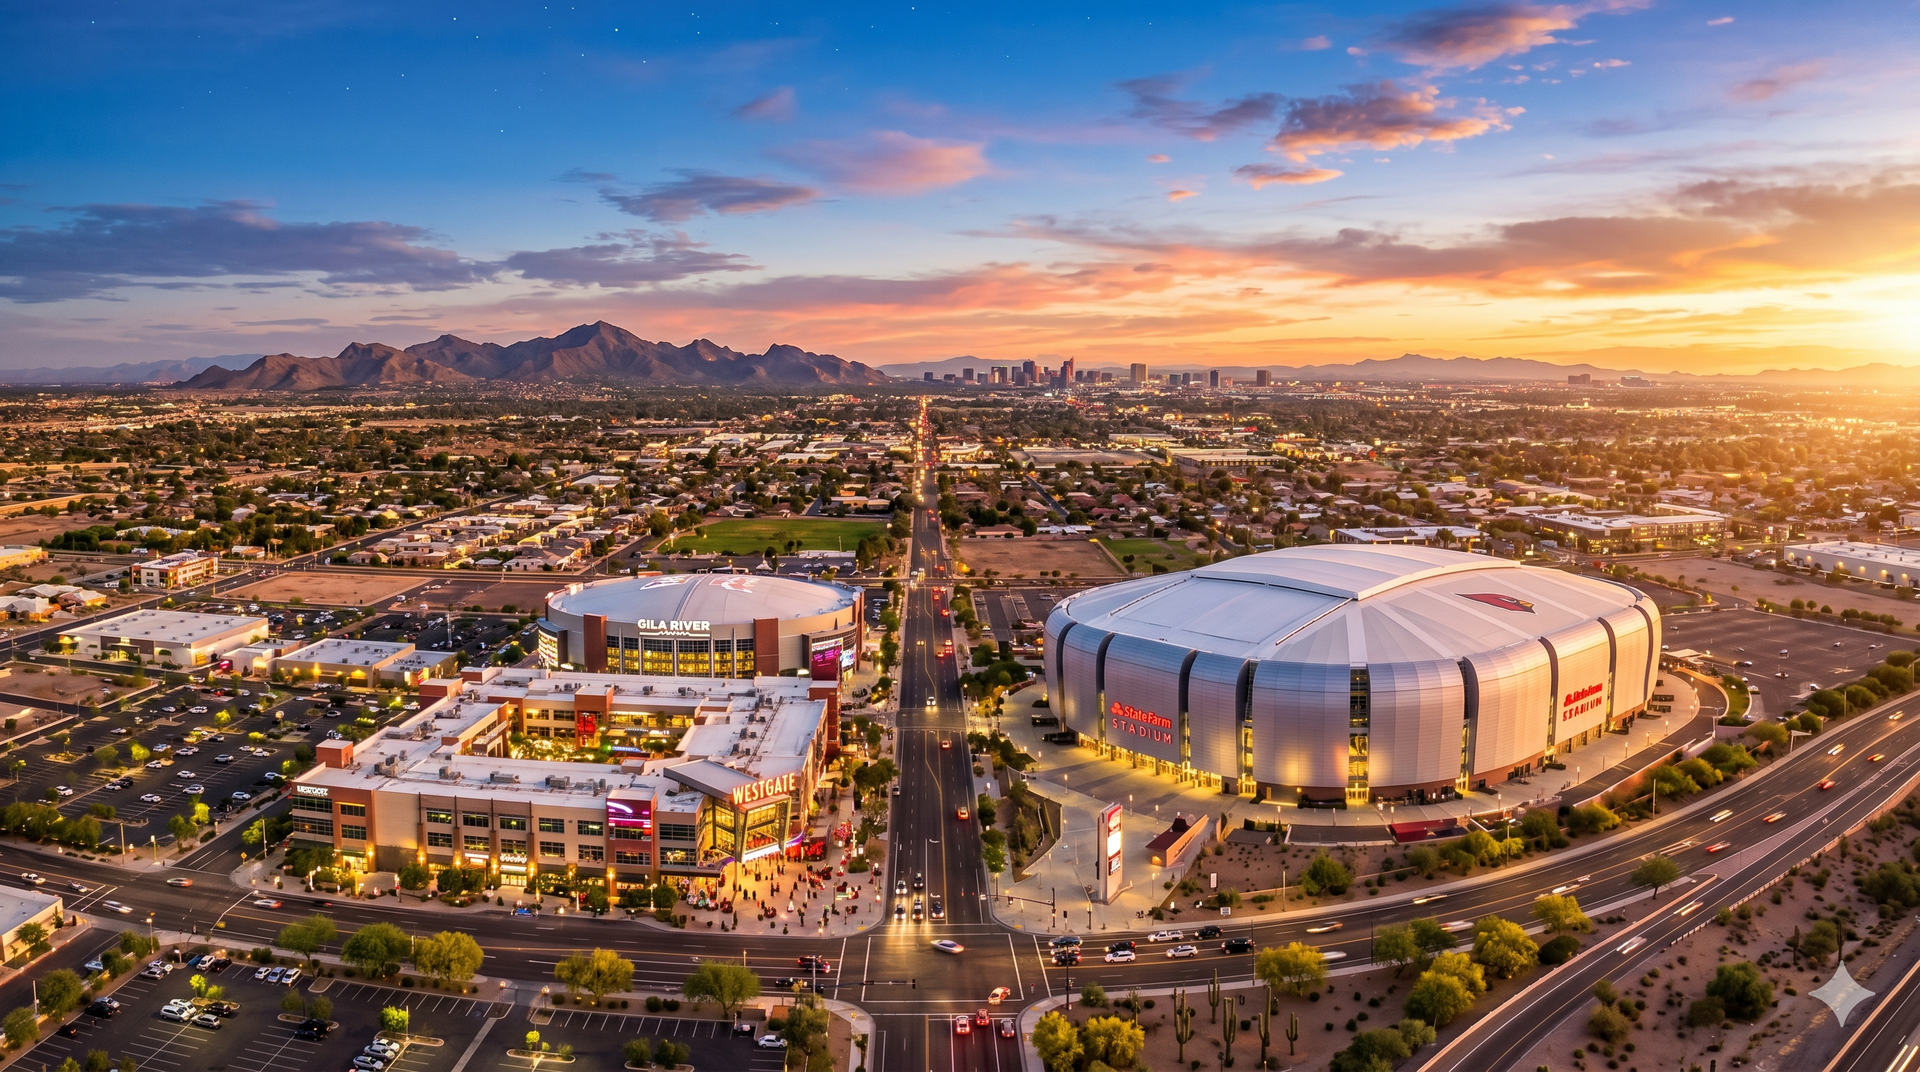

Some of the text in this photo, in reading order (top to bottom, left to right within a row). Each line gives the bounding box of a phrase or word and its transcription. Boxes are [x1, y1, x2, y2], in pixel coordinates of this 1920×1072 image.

[637, 618, 711, 631] GILA RIVER
[1112, 718, 1173, 745] STADIUM
[732, 772, 796, 805] WESTGATE
